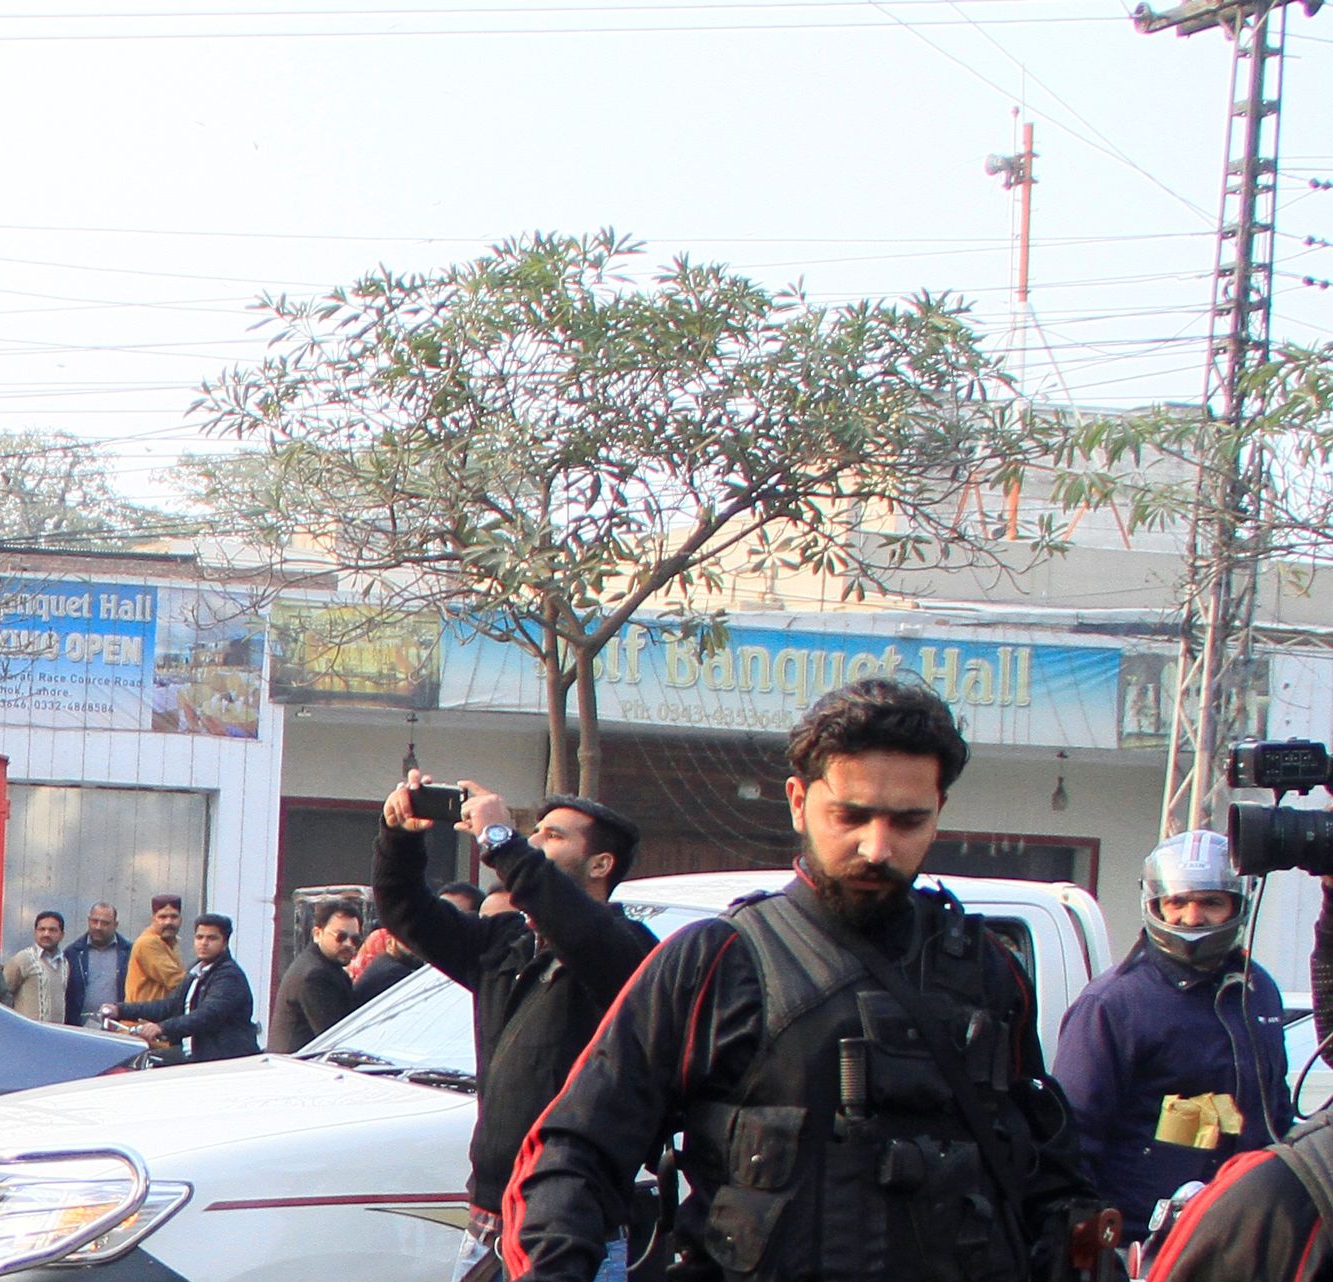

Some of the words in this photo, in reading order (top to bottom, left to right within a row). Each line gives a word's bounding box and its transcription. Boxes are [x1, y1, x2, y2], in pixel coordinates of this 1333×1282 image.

[99, 592, 152, 622] Hall
[65, 632, 143, 666] OPEN
[38, 672, 67, 683] Race
[918, 645, 1032, 707] Hall
